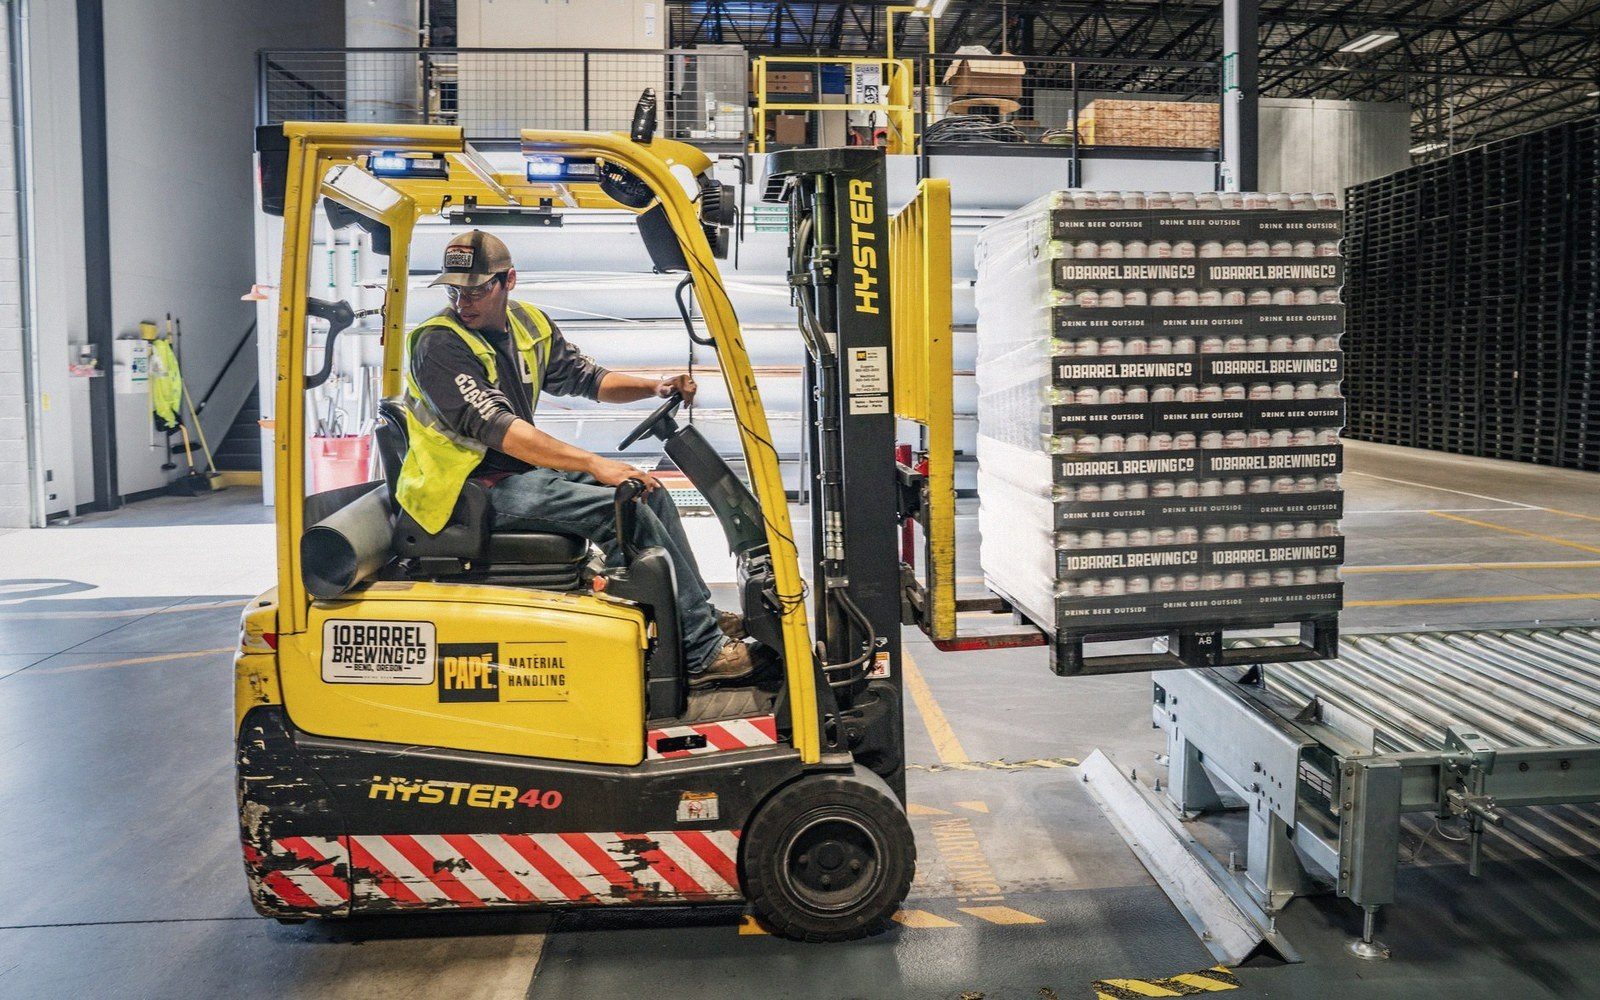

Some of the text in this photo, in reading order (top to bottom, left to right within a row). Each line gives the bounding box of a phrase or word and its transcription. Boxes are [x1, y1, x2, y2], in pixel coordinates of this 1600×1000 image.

[849, 179, 879, 314] HYSTER
[1198, 636, 1212, 645] A-B
[509, 657, 565, 668] MATERIAL
[508, 674, 565, 686] HANDLING
